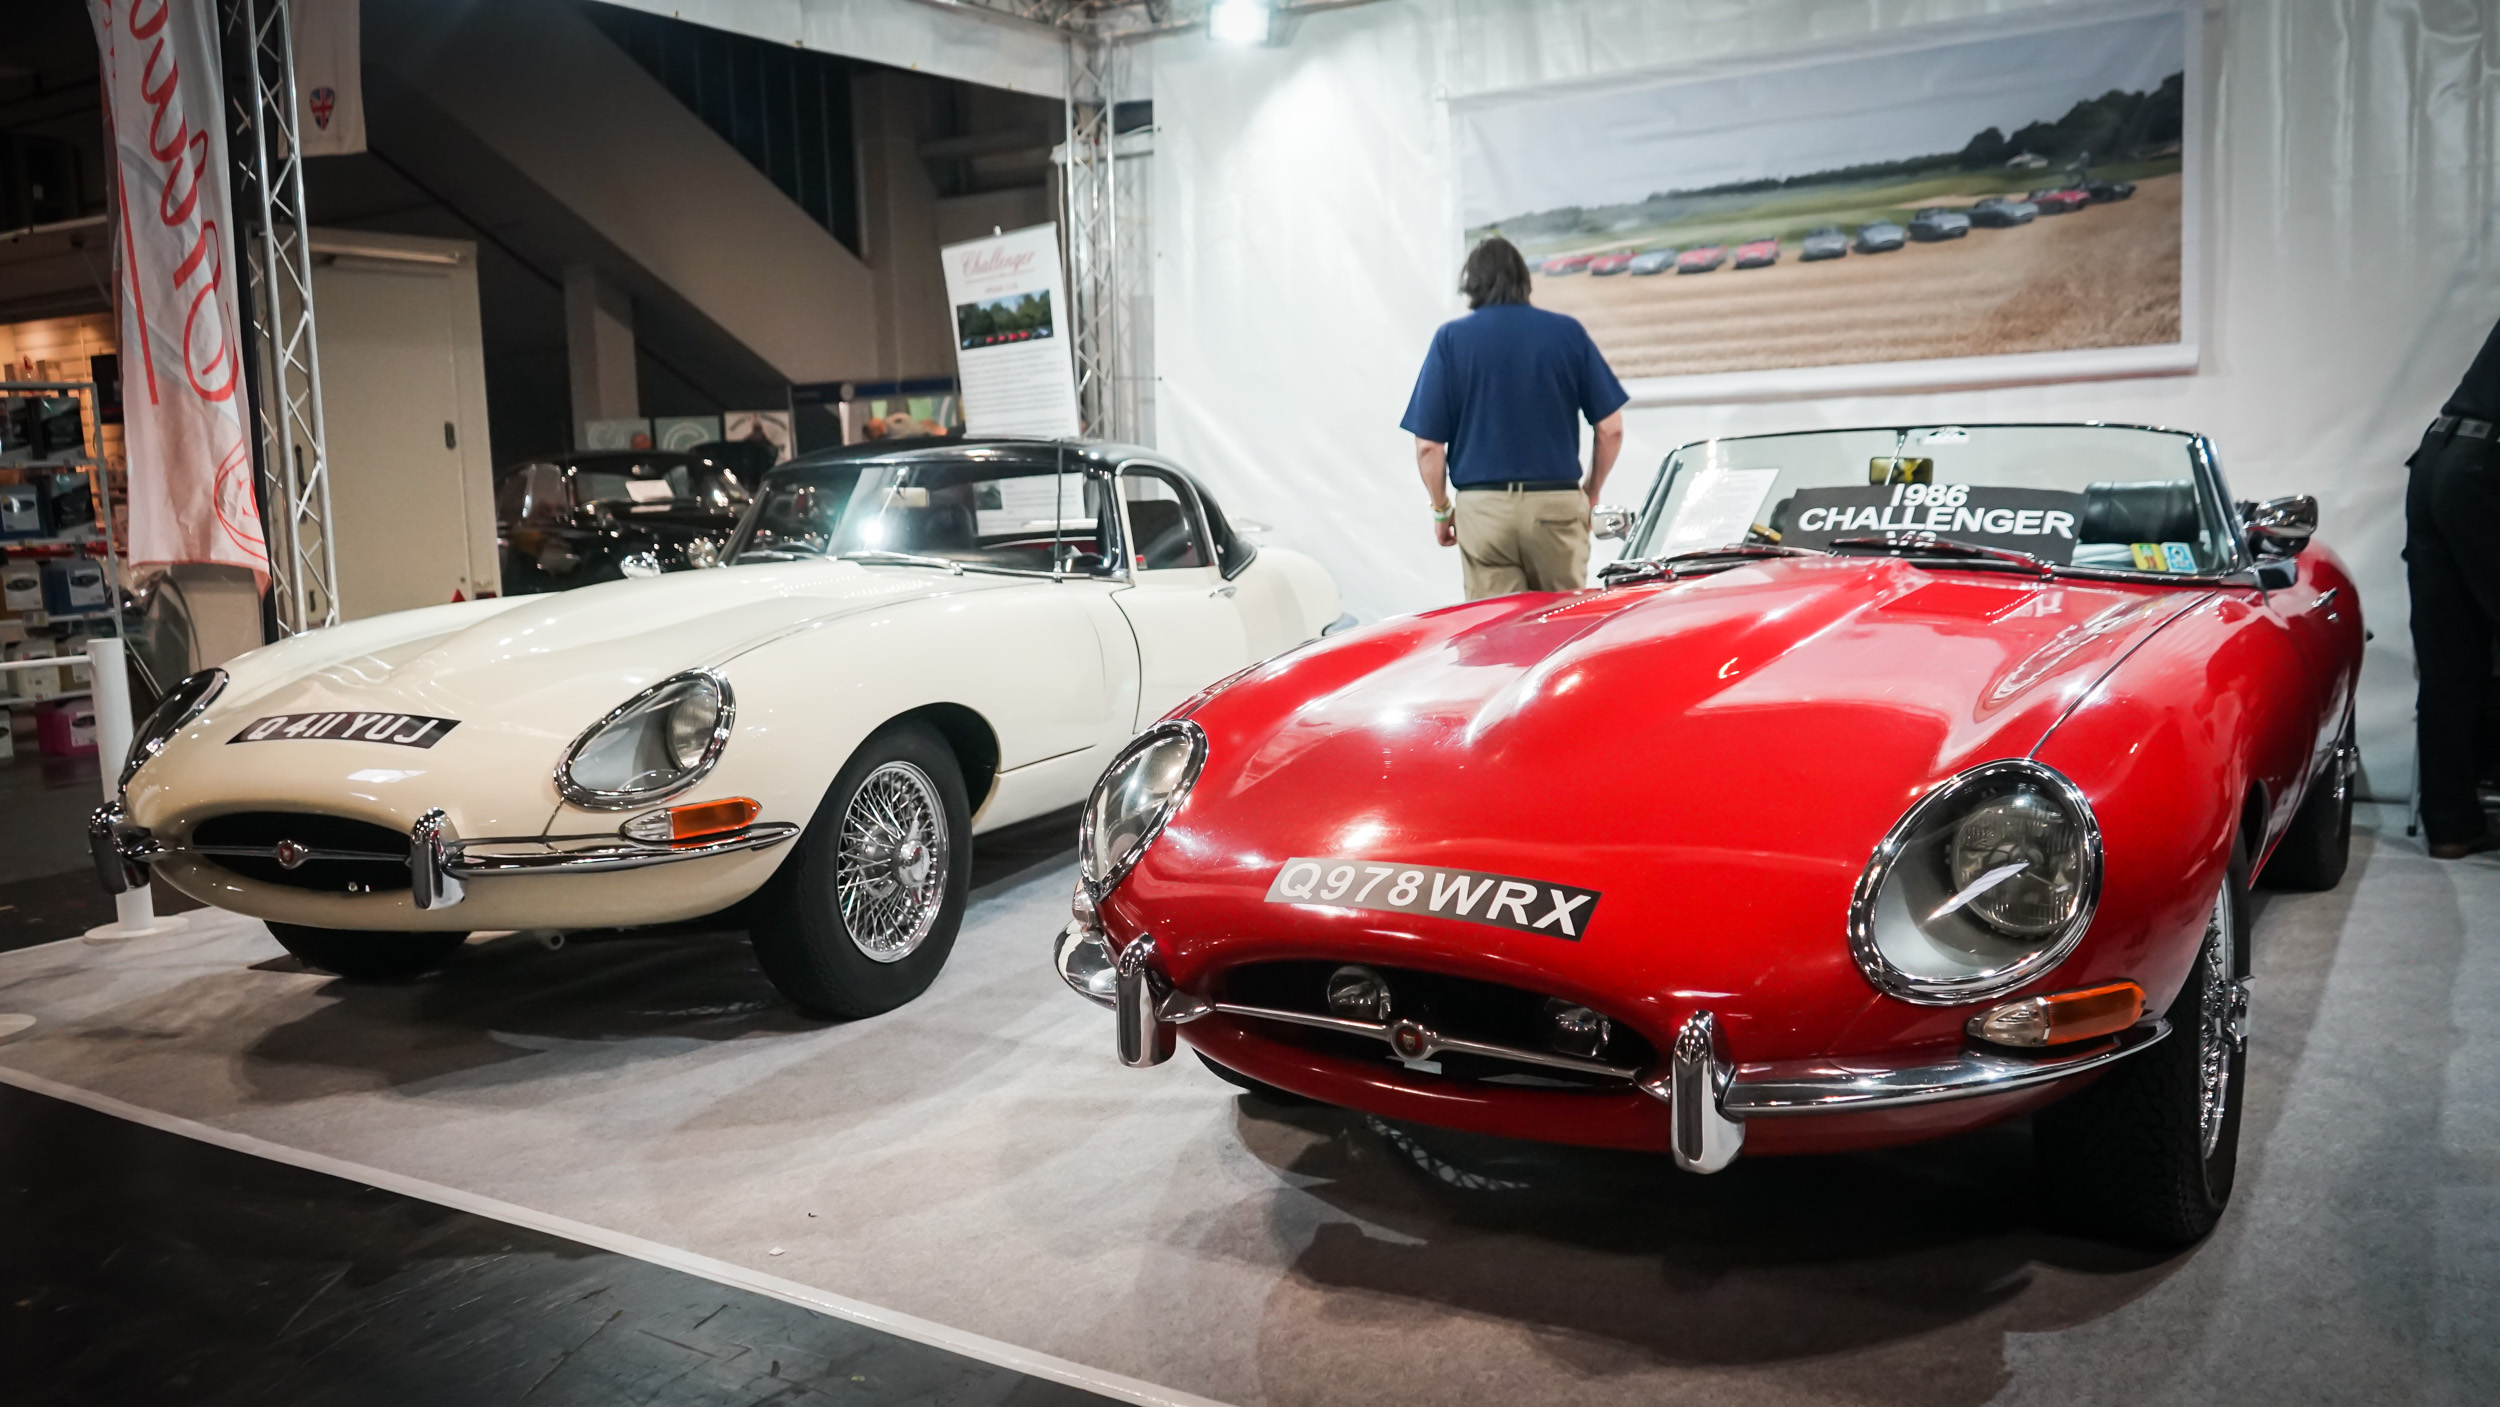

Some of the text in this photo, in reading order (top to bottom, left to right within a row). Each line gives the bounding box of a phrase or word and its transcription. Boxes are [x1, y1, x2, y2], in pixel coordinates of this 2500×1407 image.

[1890, 482, 1970, 507] 1986
[1798, 506, 2075, 539] CHALLENGER
[1279, 862, 1592, 937] Q978WRX
